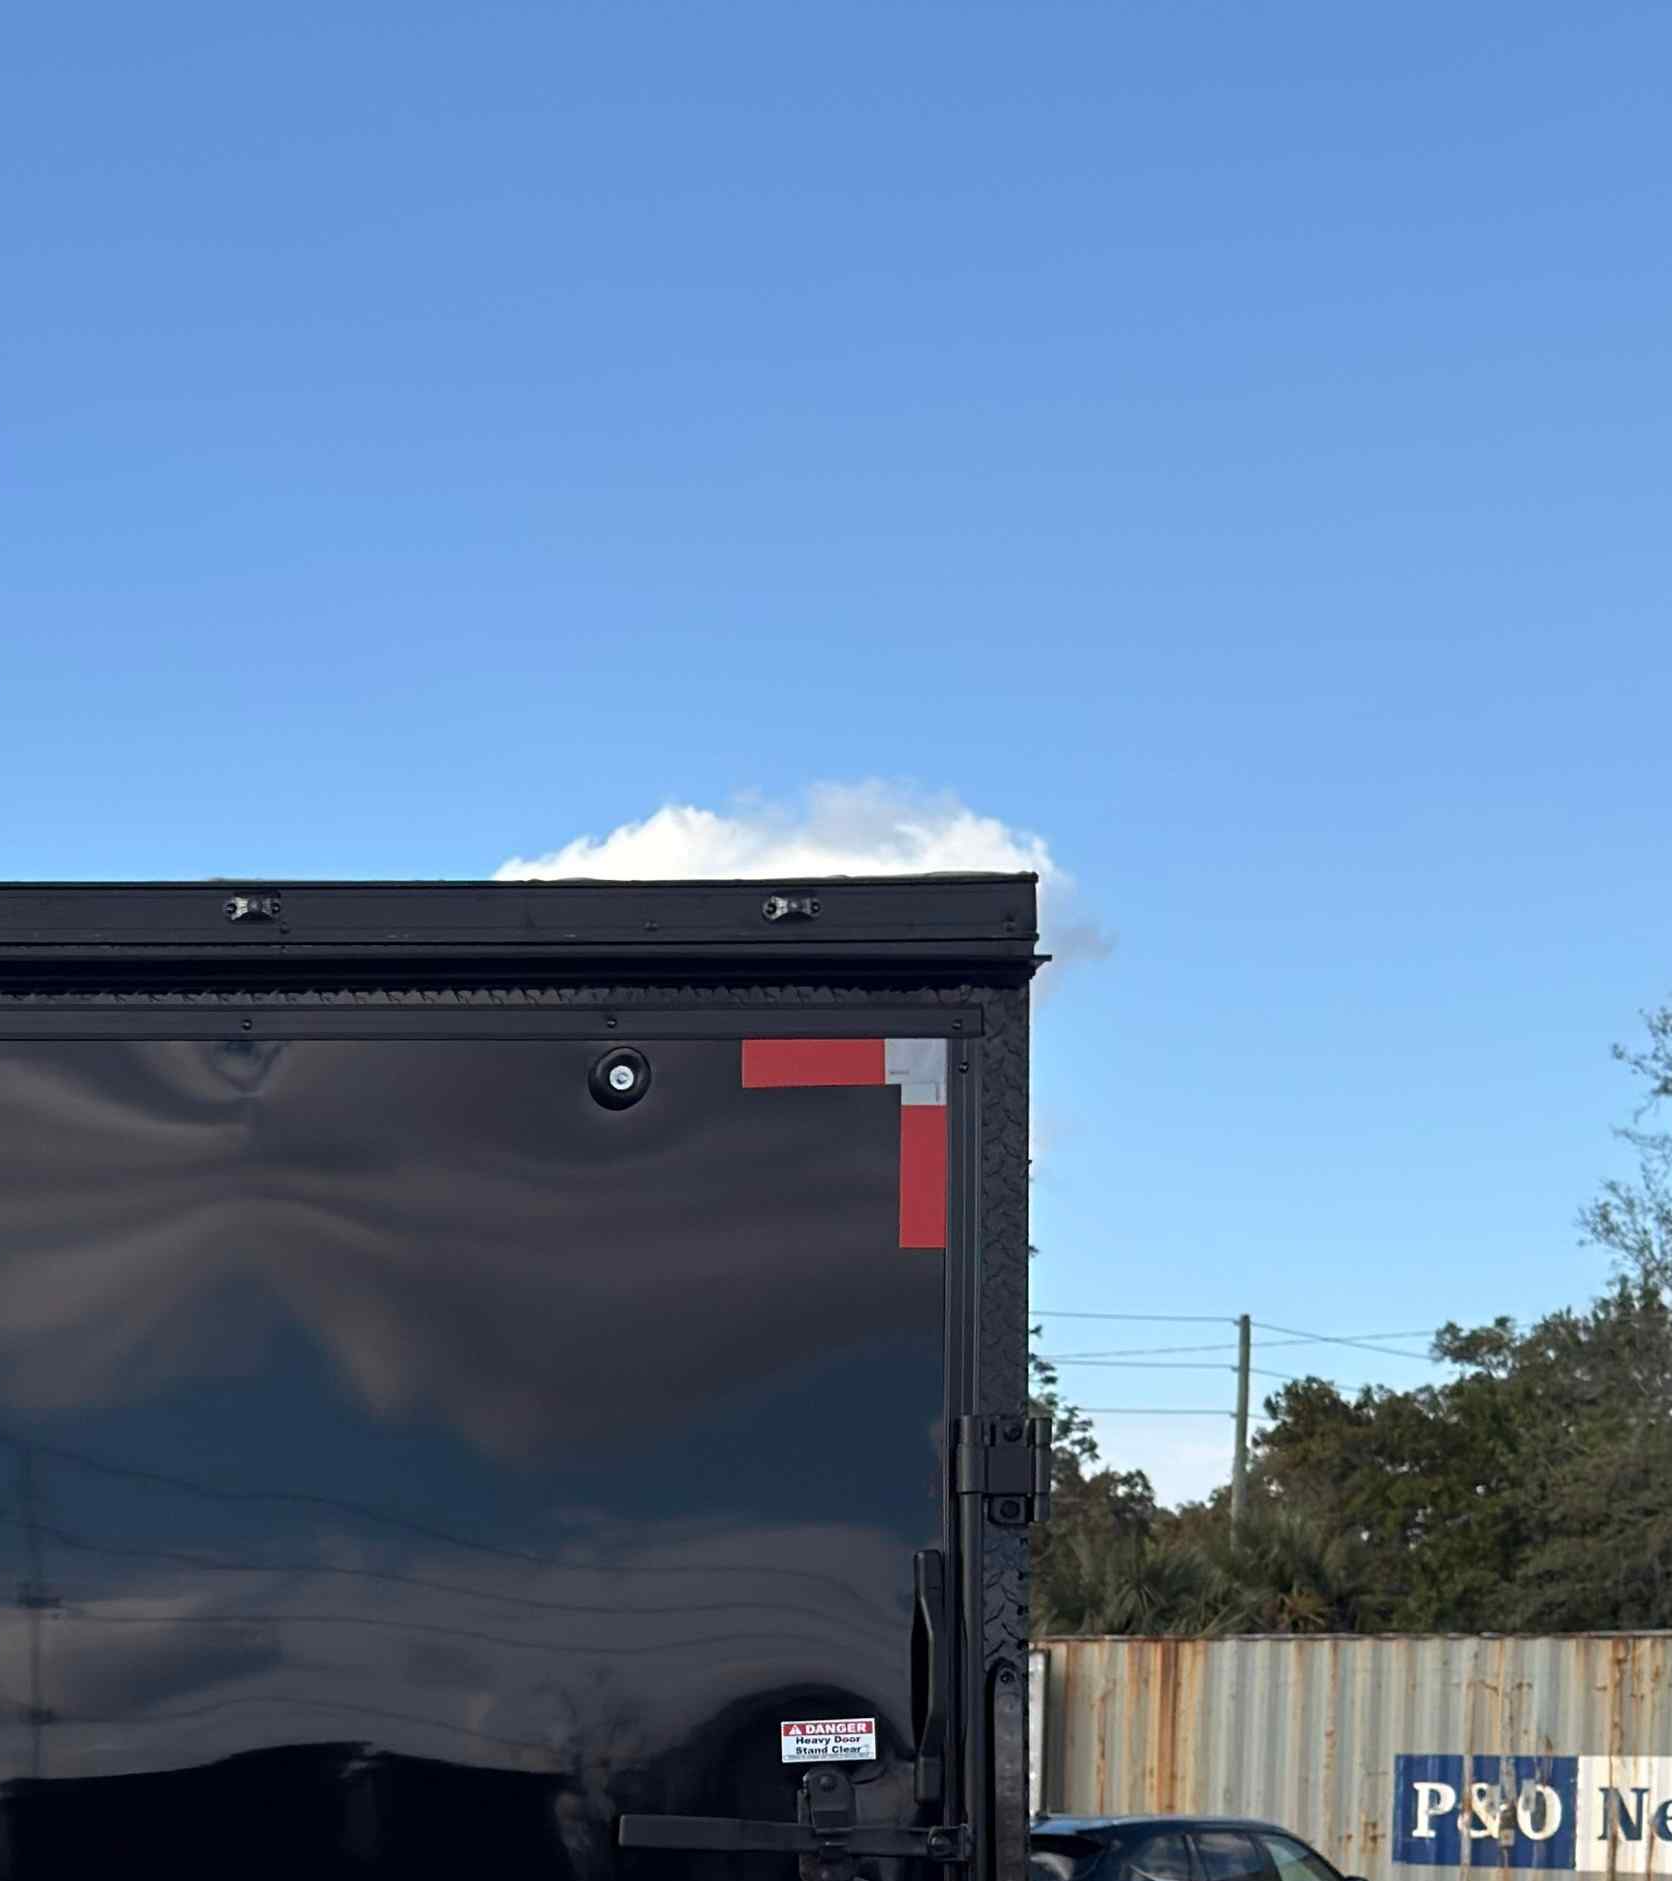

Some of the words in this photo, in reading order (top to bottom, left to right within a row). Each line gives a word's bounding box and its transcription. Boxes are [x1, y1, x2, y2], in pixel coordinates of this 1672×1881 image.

[805, 1723, 867, 1735] DANGER
[796, 1736, 831, 1745] Heavy
[834, 1735, 861, 1743] Door
[795, 1746, 828, 1755] Stand
[832, 1745, 861, 1754] Clear
[1412, 1781, 1563, 1841] P&O
